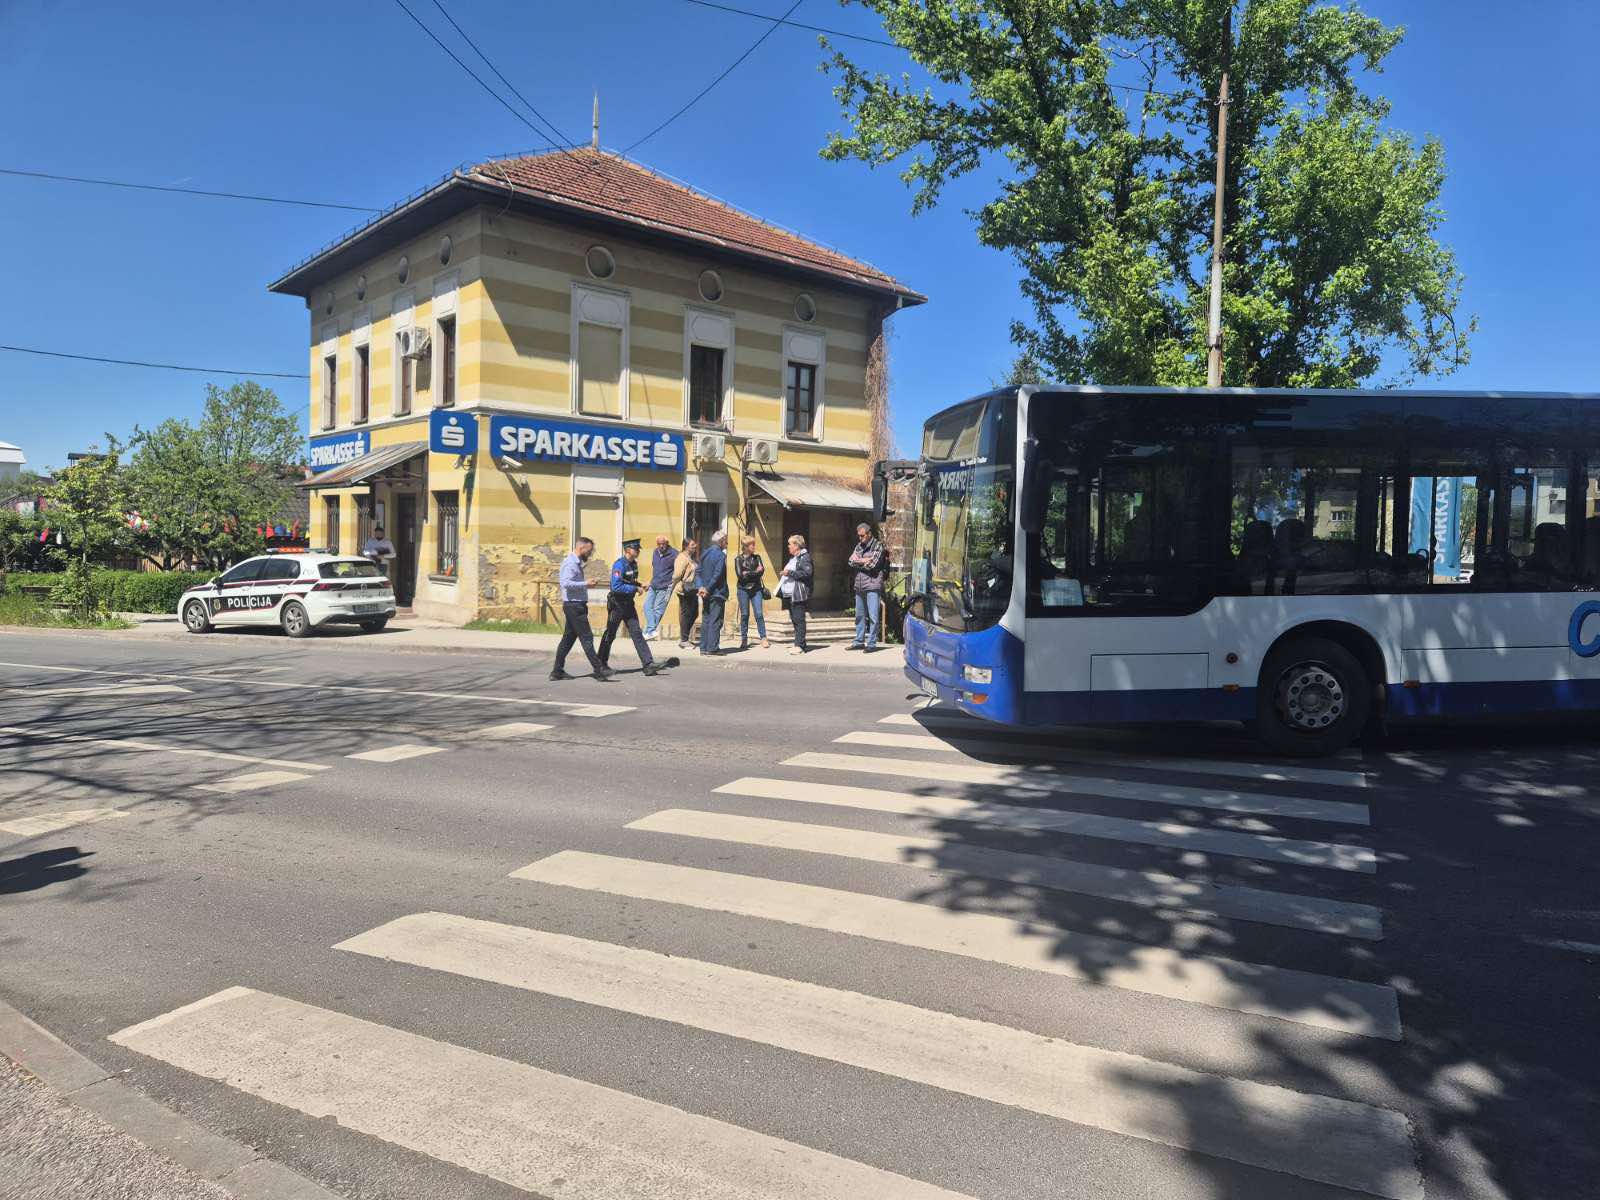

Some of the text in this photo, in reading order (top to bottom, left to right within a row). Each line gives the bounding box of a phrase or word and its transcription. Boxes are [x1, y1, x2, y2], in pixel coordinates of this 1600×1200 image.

[311, 440, 355, 466] SPARKASSE
[500, 426, 650, 463] SPARKASSE
[1434, 477, 1450, 564] SPARKAS
[227, 596, 272, 608] POLICIJA
